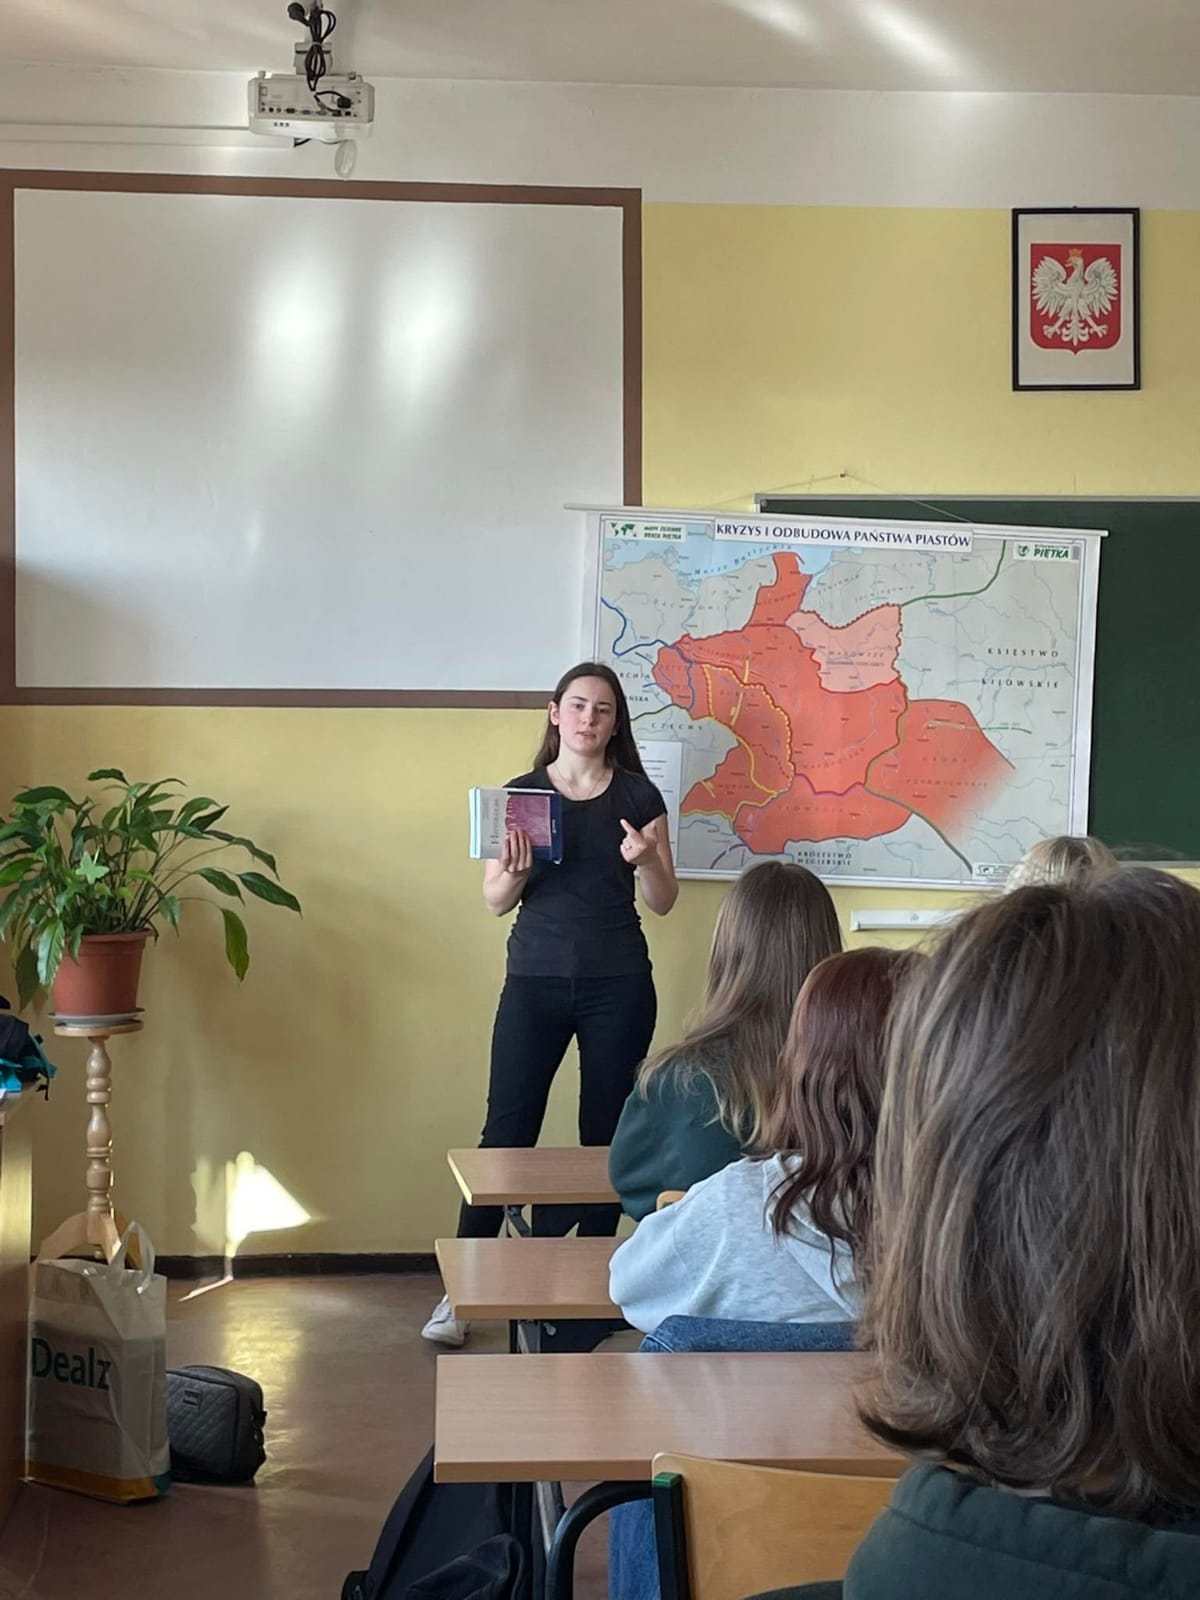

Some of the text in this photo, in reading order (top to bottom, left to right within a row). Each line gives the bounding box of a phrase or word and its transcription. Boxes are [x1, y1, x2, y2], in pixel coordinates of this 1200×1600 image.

[716, 523, 972, 547] KRYZYS I ODBUDOWA PAŃSTWA PIASTÓW
[1033, 548, 1069, 559] PIĘTKA
[987, 647, 1060, 658] KSIĘSTWO
[981, 678, 1060, 689] KIJOWSKIE
[31, 1336, 112, 1391] Dealz
